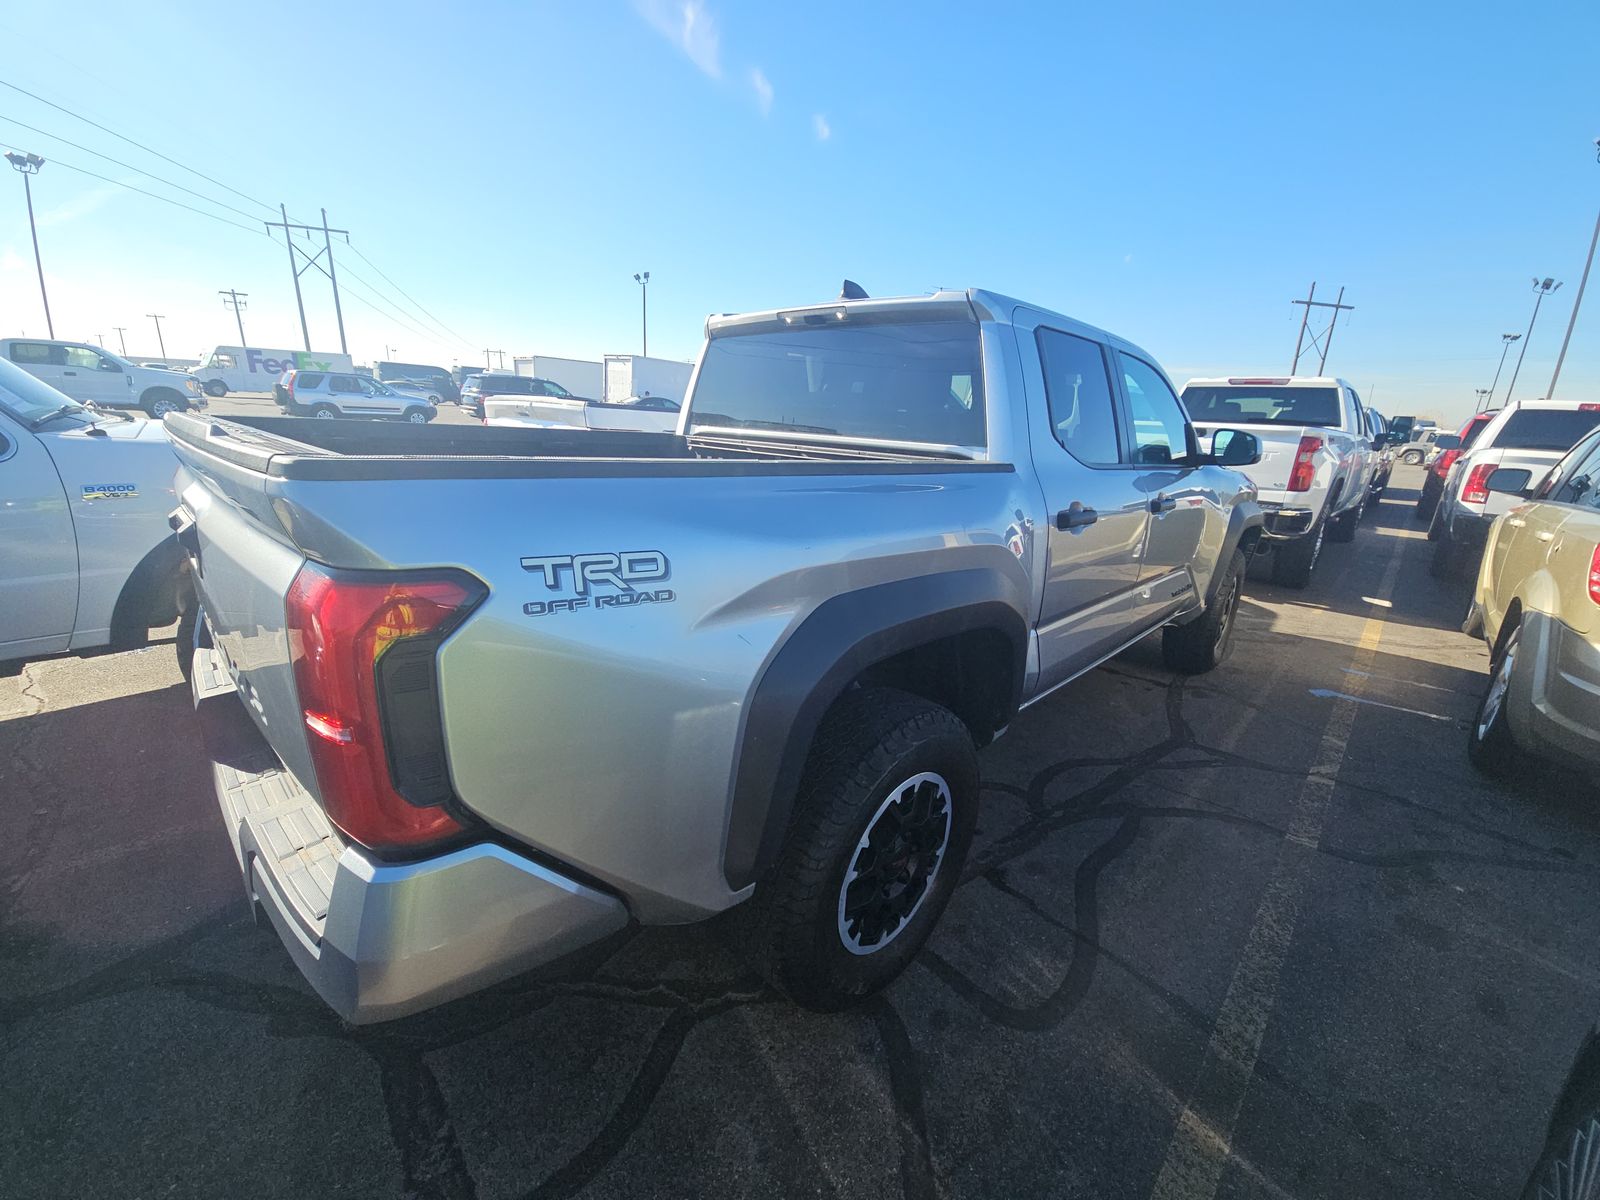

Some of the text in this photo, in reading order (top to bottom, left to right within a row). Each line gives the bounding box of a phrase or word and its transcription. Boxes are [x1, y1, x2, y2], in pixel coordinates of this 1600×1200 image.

[246, 350, 332, 375] FedEx
[84, 484, 136, 493] B4000
[520, 550, 671, 596] TRD
[523, 589, 676, 617] OFF ROAD
